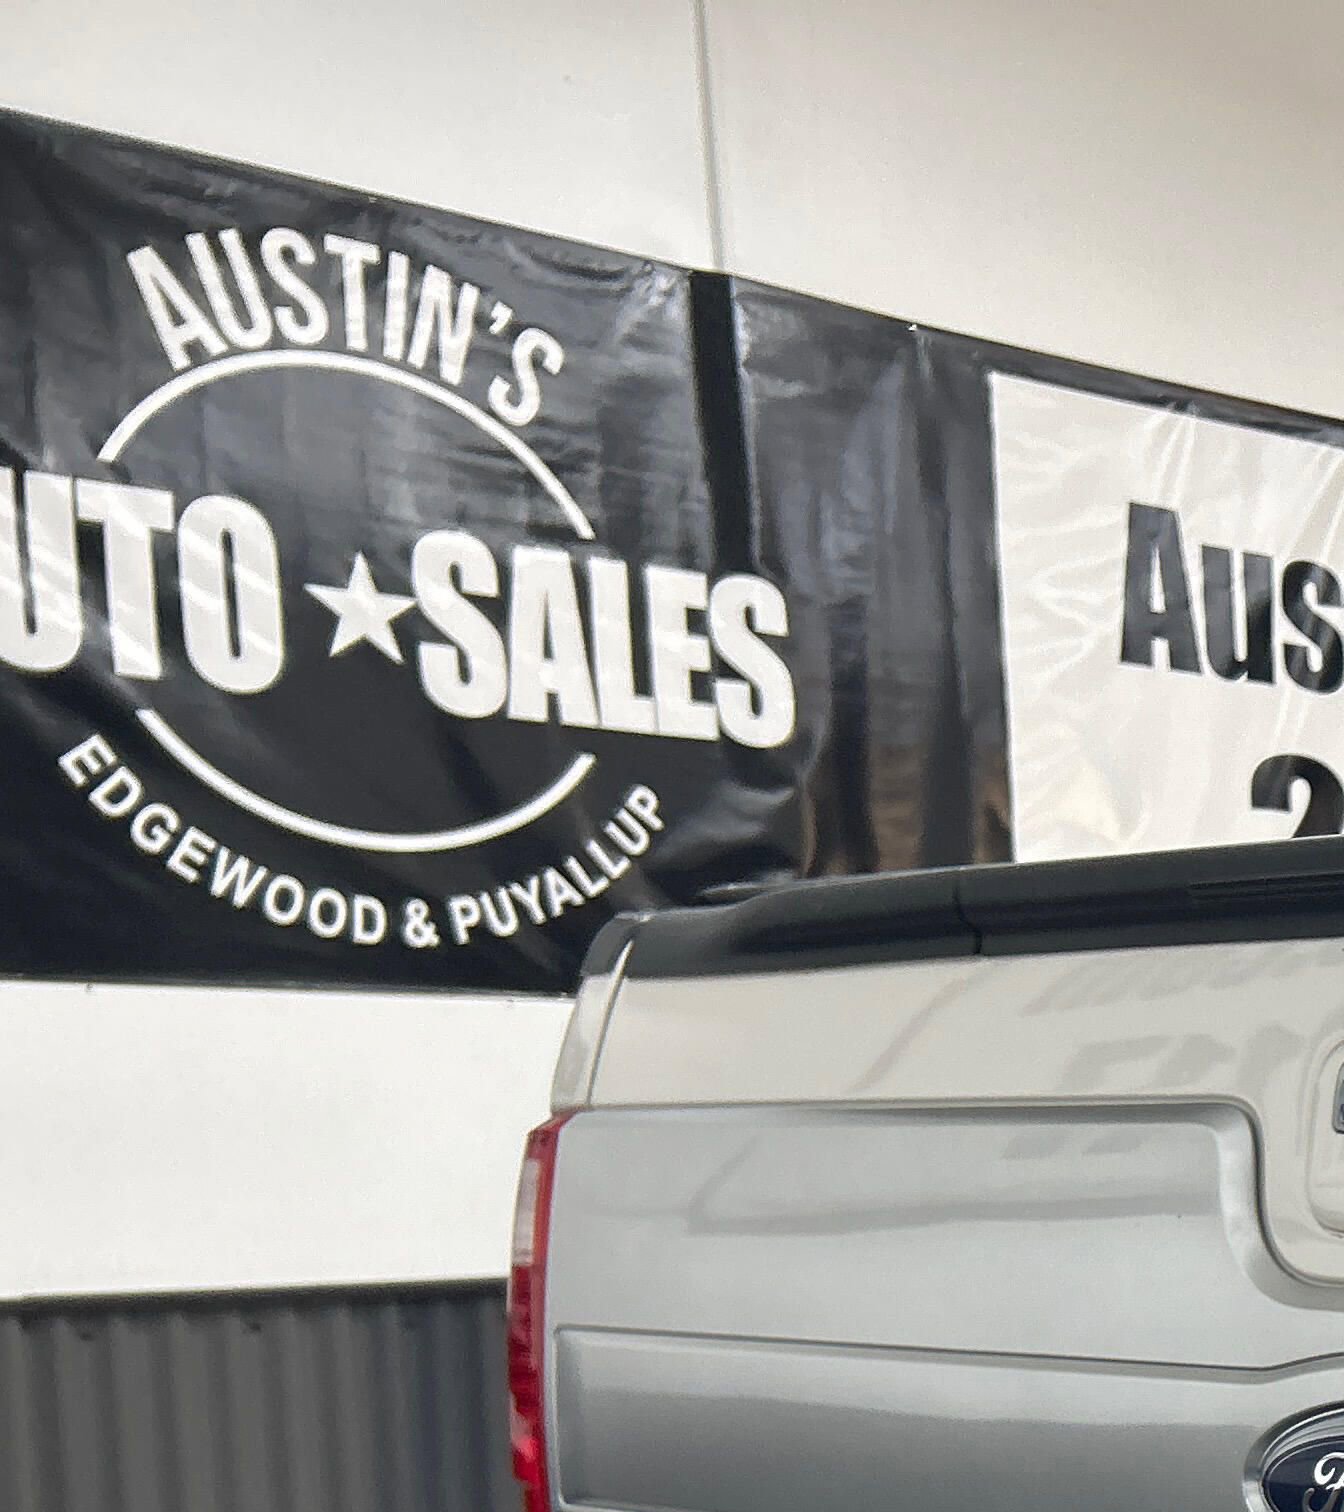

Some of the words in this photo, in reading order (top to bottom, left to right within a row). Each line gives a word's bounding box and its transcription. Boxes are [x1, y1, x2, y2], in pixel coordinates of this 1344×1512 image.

[128, 226, 566, 428] AUSTIN'S
[0, 465, 284, 694] UTO
[410, 529, 796, 748] SALES
[58, 732, 389, 948] EDGEWOOD
[404, 902, 441, 950] &
[450, 783, 667, 946] PUYALLUP
